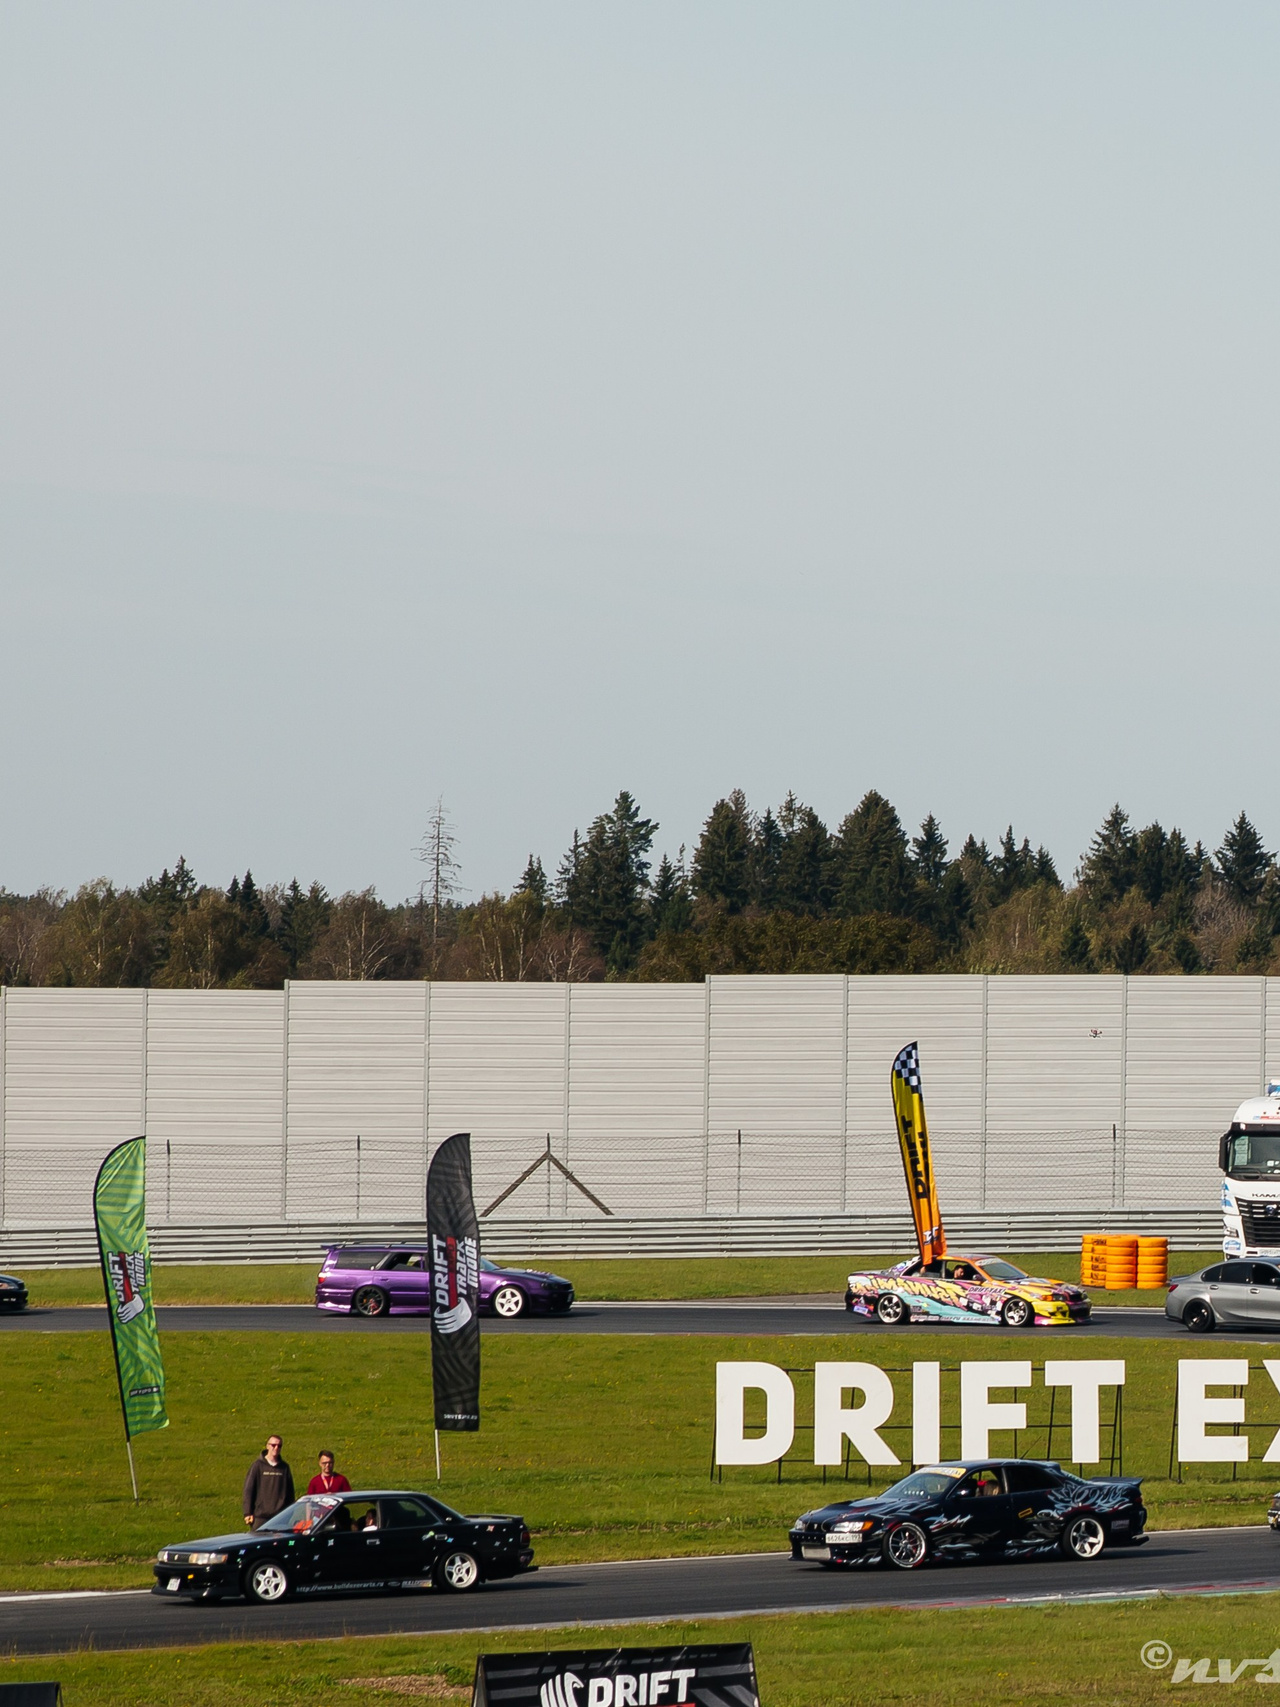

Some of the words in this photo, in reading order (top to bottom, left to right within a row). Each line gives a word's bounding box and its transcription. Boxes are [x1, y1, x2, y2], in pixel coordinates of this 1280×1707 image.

[108, 1253, 125, 1302] DRIFT
[432, 1234, 449, 1306] DRIFT
[456, 1240, 467, 1295] TRACK
[464, 1236, 478, 1288] MODE
[715, 1361, 1126, 1466] DRIFT
[588, 1668, 696, 1707] DRIFT
